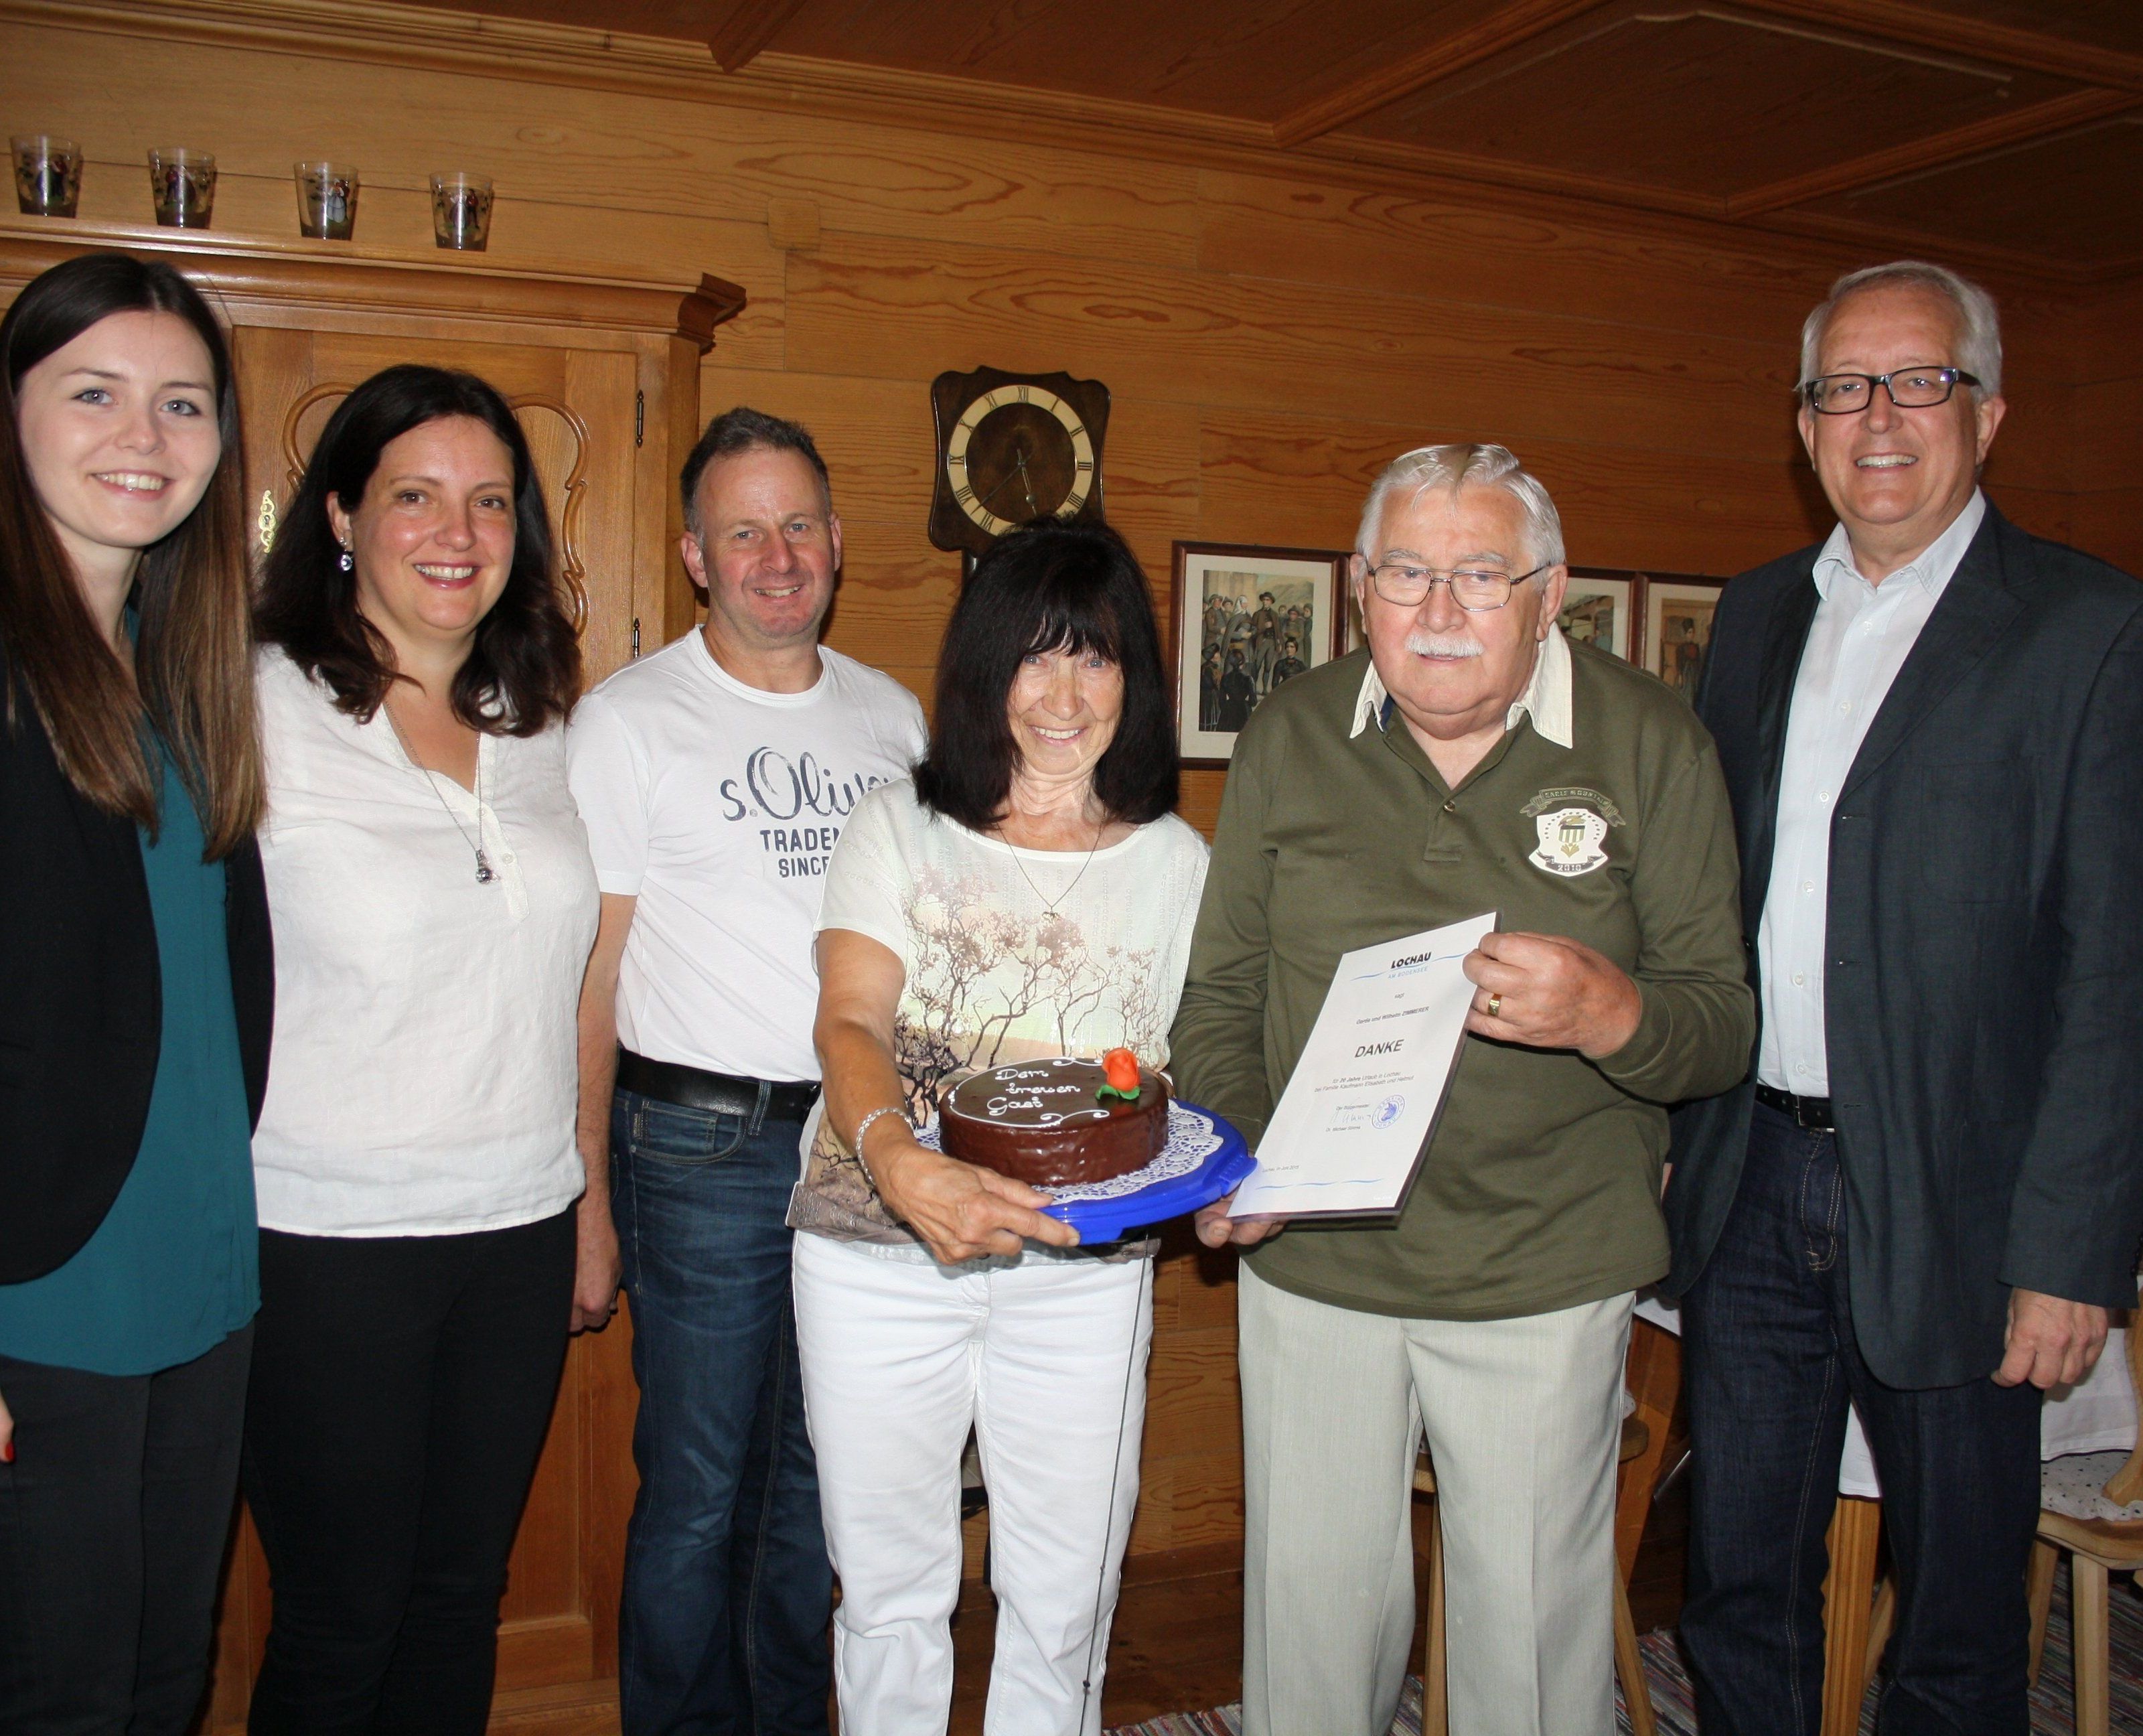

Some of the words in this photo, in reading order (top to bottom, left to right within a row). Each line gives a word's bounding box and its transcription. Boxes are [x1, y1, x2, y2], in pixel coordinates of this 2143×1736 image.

[984, 392, 999, 411] XI
[1017, 386, 1029, 403] XII
[1391, 952, 1432, 969] LOCHAU
[1354, 1039, 1405, 1058] DANKE
[1006, 1082, 1081, 1094] treuen
[986, 1096, 1044, 1116] Gast
